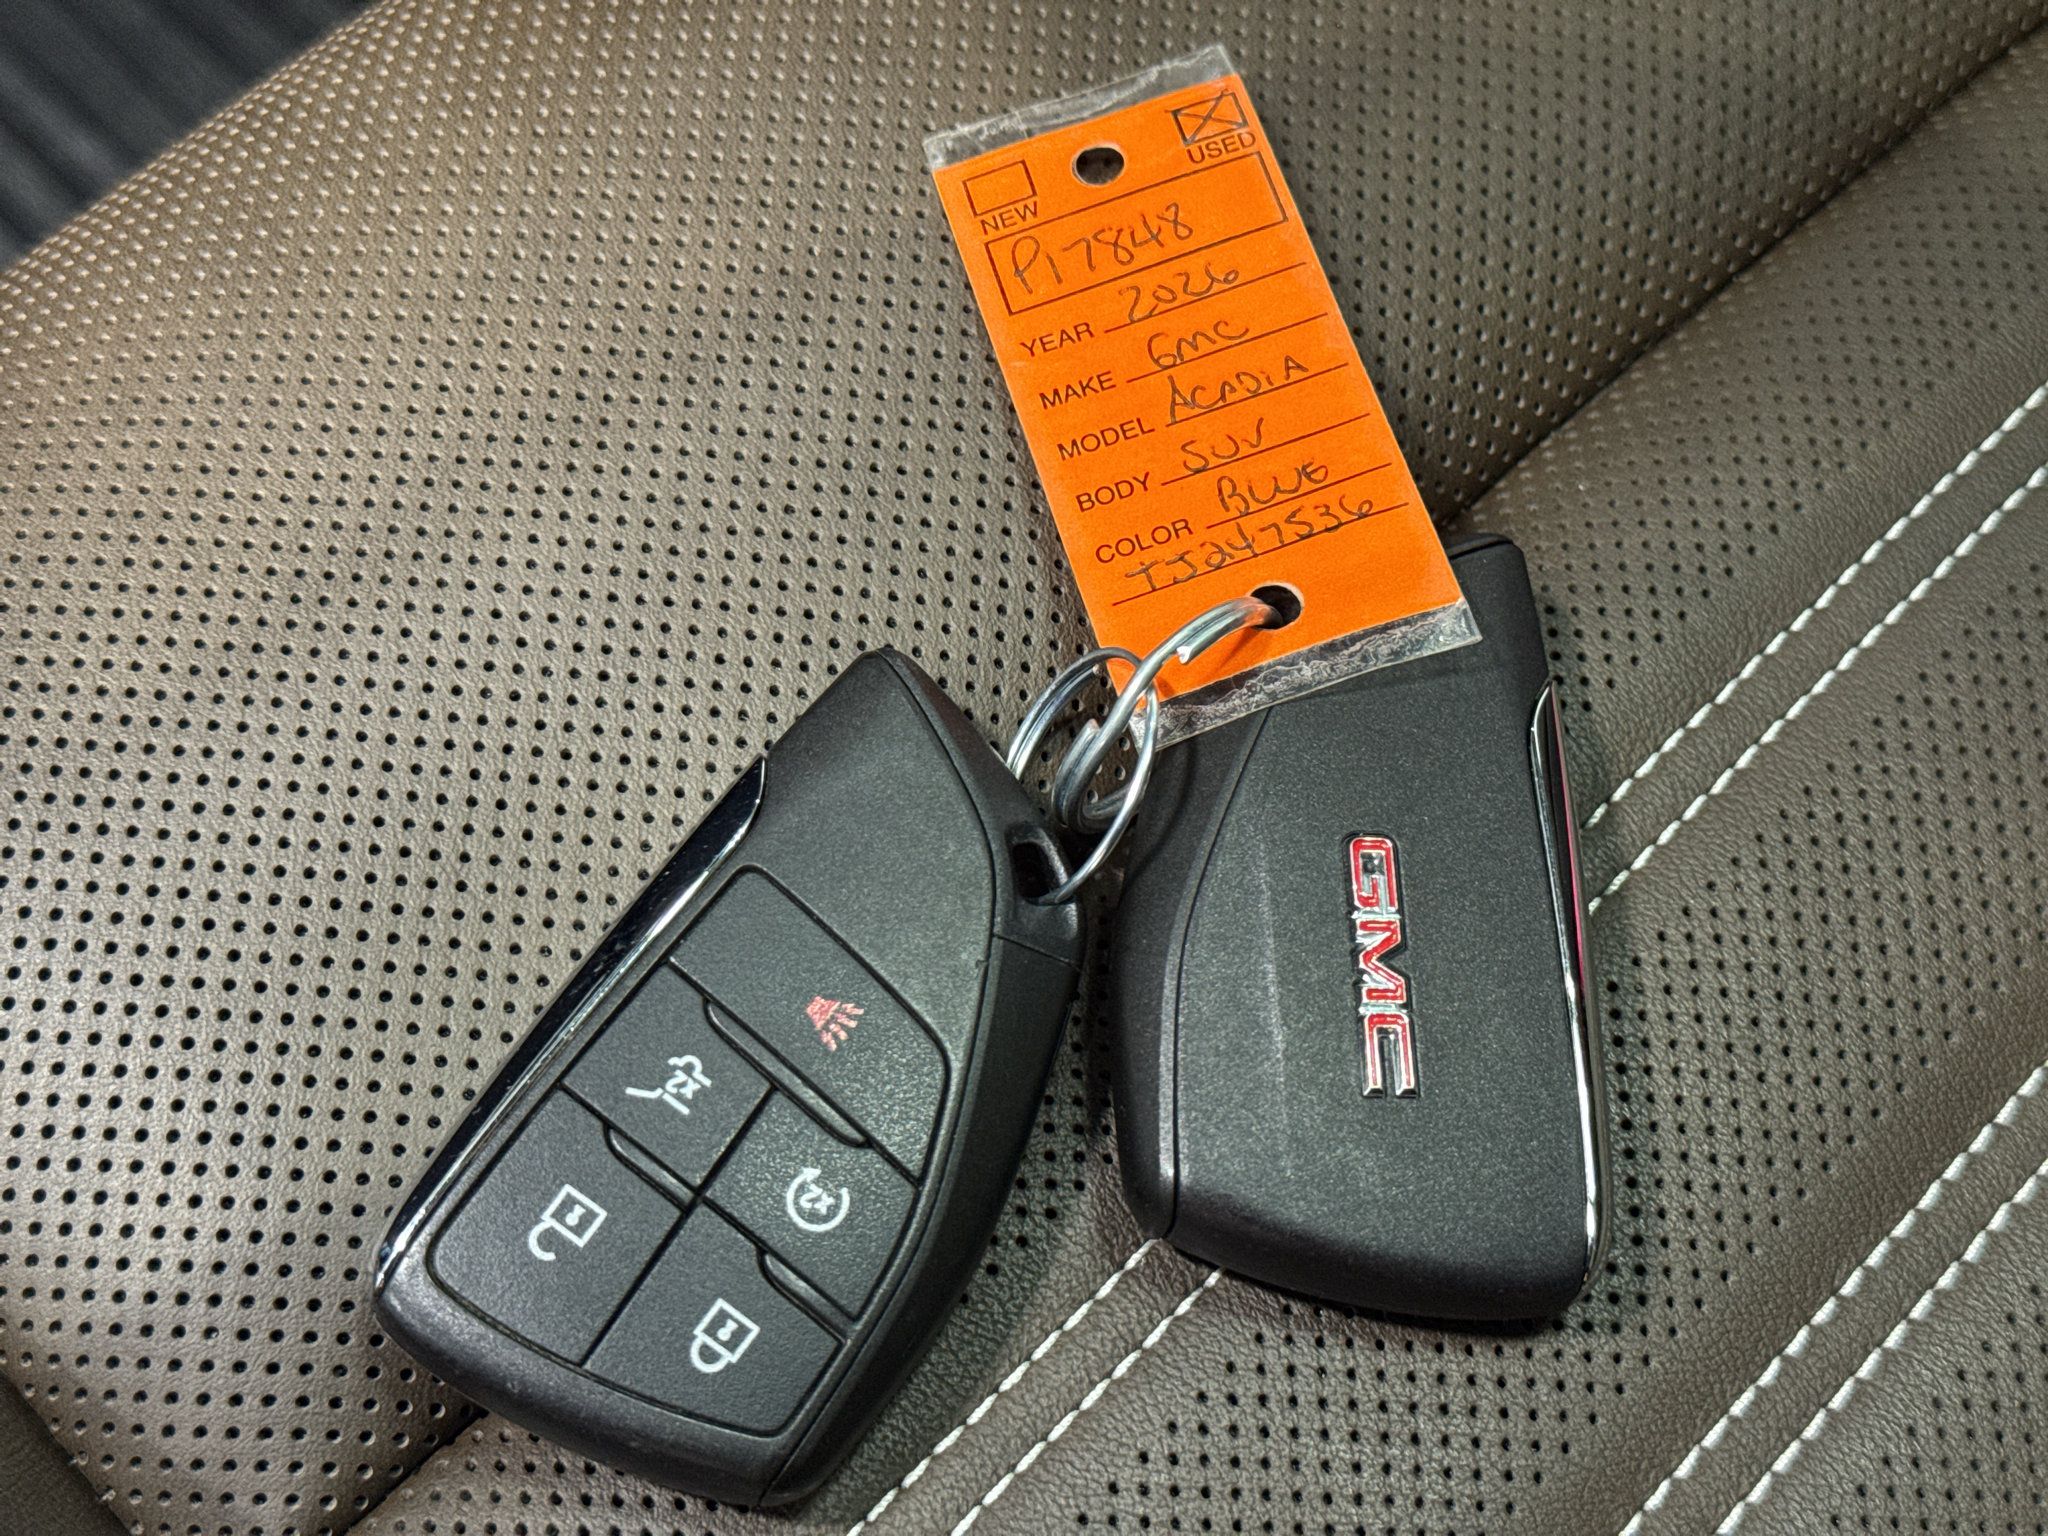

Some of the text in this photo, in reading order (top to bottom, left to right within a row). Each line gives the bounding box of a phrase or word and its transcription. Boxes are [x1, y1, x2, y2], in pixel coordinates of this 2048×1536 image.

[1186, 131, 1257, 164] USED
[980, 201, 1039, 235] NEW
[1119, 262, 1240, 322] 2026
[1020, 321, 1095, 358] YEAR
[1039, 370, 1117, 411] MAKE
[1056, 416, 1155, 461] MODEL
[1181, 417, 1266, 474] SUV
[1075, 471, 1152, 513] BODY
[1094, 518, 1194, 565] COLOR
[1345, 834, 1417, 1098] GMC
